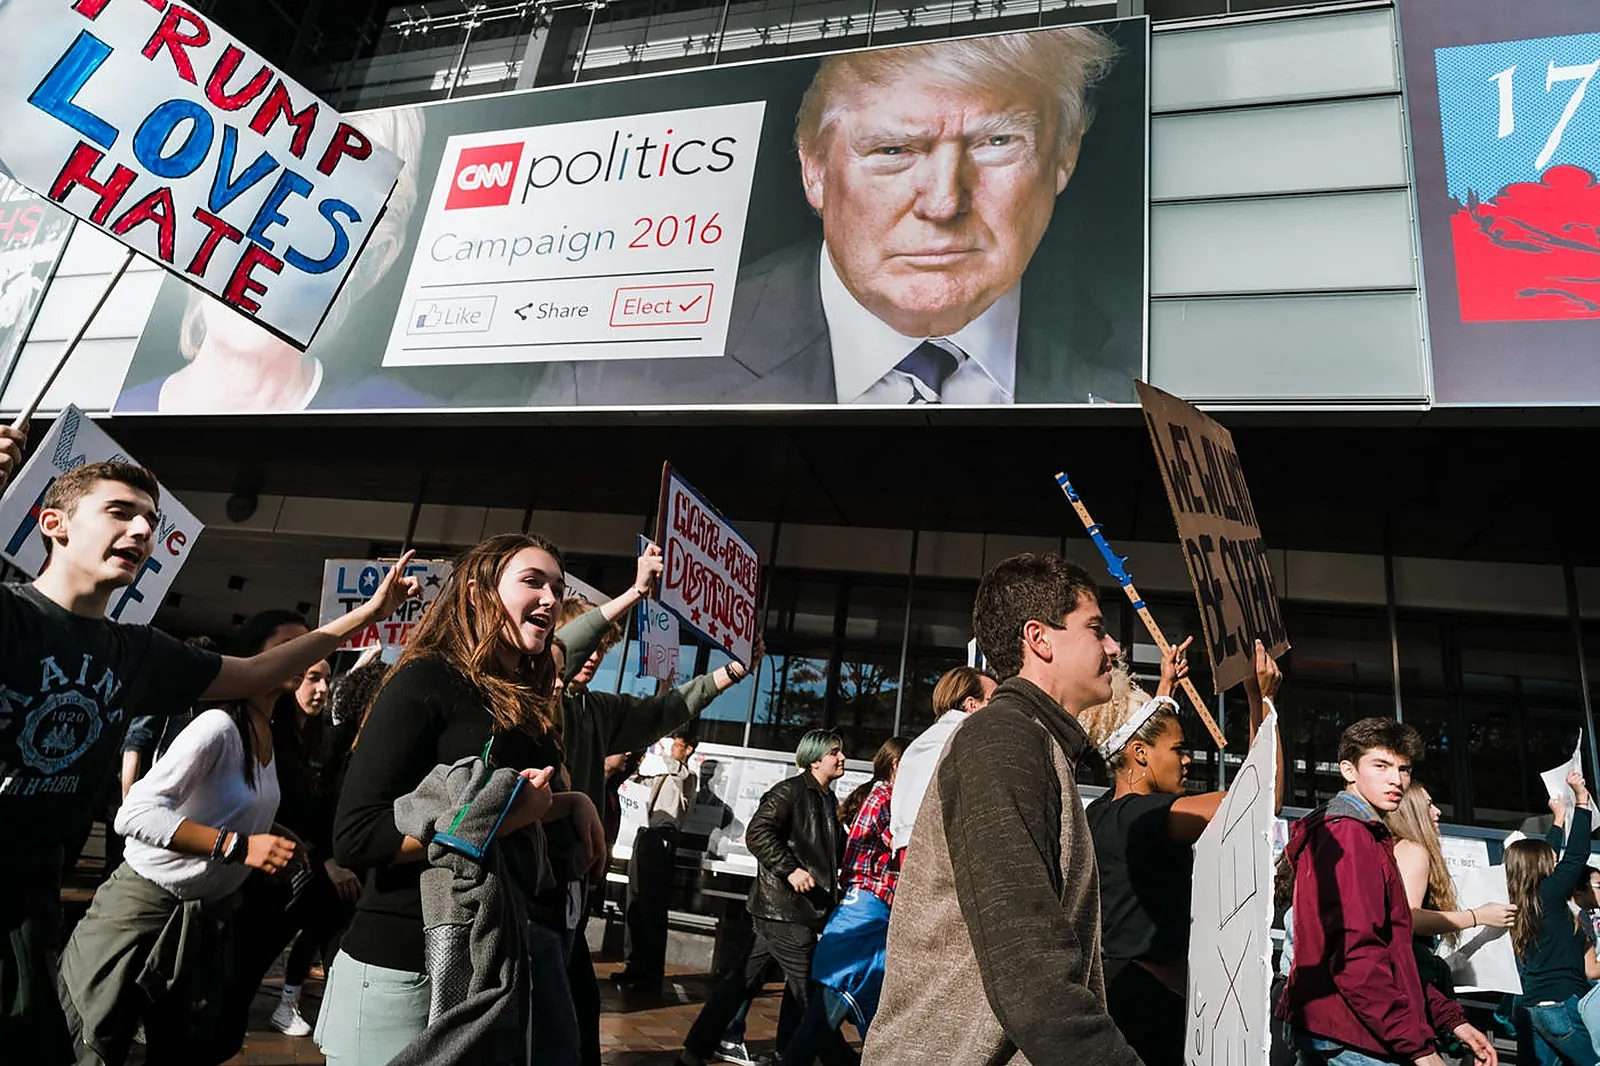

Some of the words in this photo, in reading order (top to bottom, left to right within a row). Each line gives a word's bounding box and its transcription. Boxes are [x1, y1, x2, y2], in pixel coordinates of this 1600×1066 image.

[27, 29, 362, 275] LOVES
[457, 161, 513, 191] CNN
[521, 129, 737, 204] politics
[48, 140, 285, 315] HATE
[430, 225, 615, 266] Campaign
[628, 212, 723, 249] 2016
[444, 308, 482, 327] Like
[537, 303, 589, 320] Share
[623, 298, 672, 316] Elect
[666, 536, 756, 643] DISTRICT
[1185, 535, 1238, 666] BE
